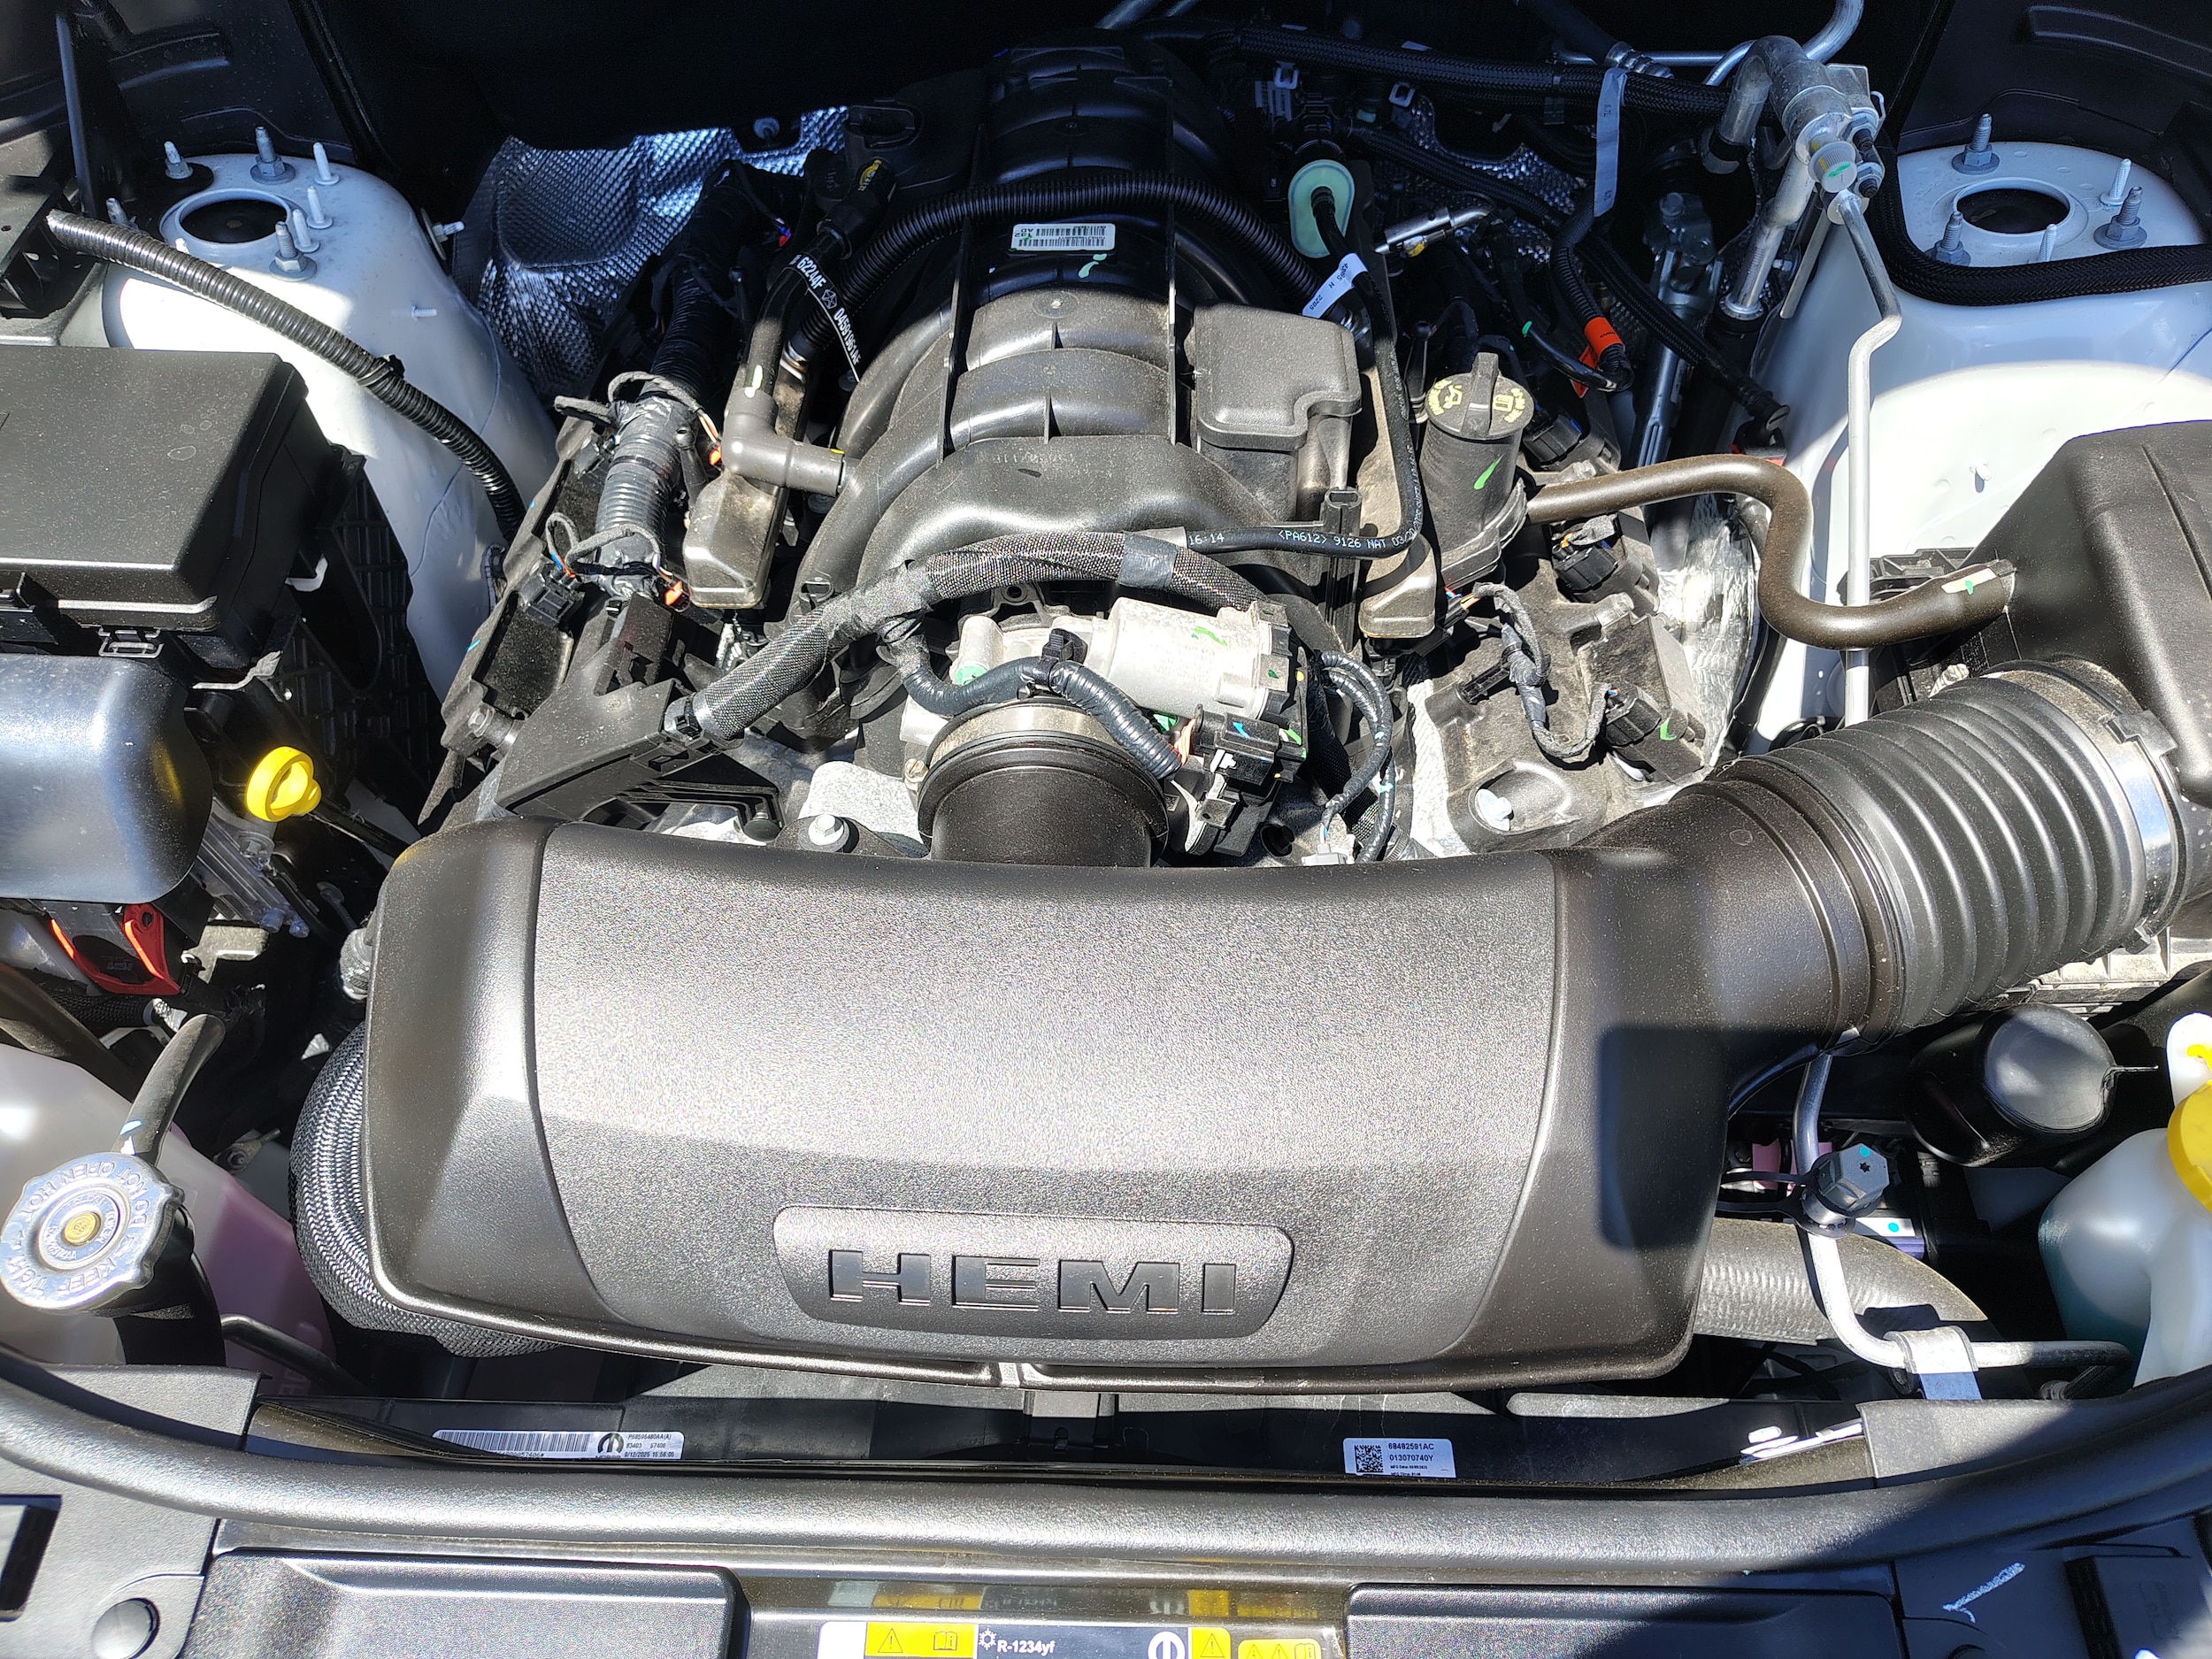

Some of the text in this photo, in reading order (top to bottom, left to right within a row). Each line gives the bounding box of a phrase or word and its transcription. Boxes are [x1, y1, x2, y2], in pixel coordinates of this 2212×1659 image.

[796, 256, 862, 366] 62244F 04591961AF
[1309, 295, 1324, 311] 2205
[1188, 533, 1225, 545] 16:14
[1279, 530, 1328, 544] <PA612>
[1333, 536, 1362, 549] 9126
[1367, 539, 1387, 549] NAT
[19, 1161, 150, 1228] DO NOT OPEN HOT
[58, 1256, 117, 1294] KEEP
[829, 1248, 1237, 1316] HEMI
[997, 1639, 1056, 1655] R-1234yf
